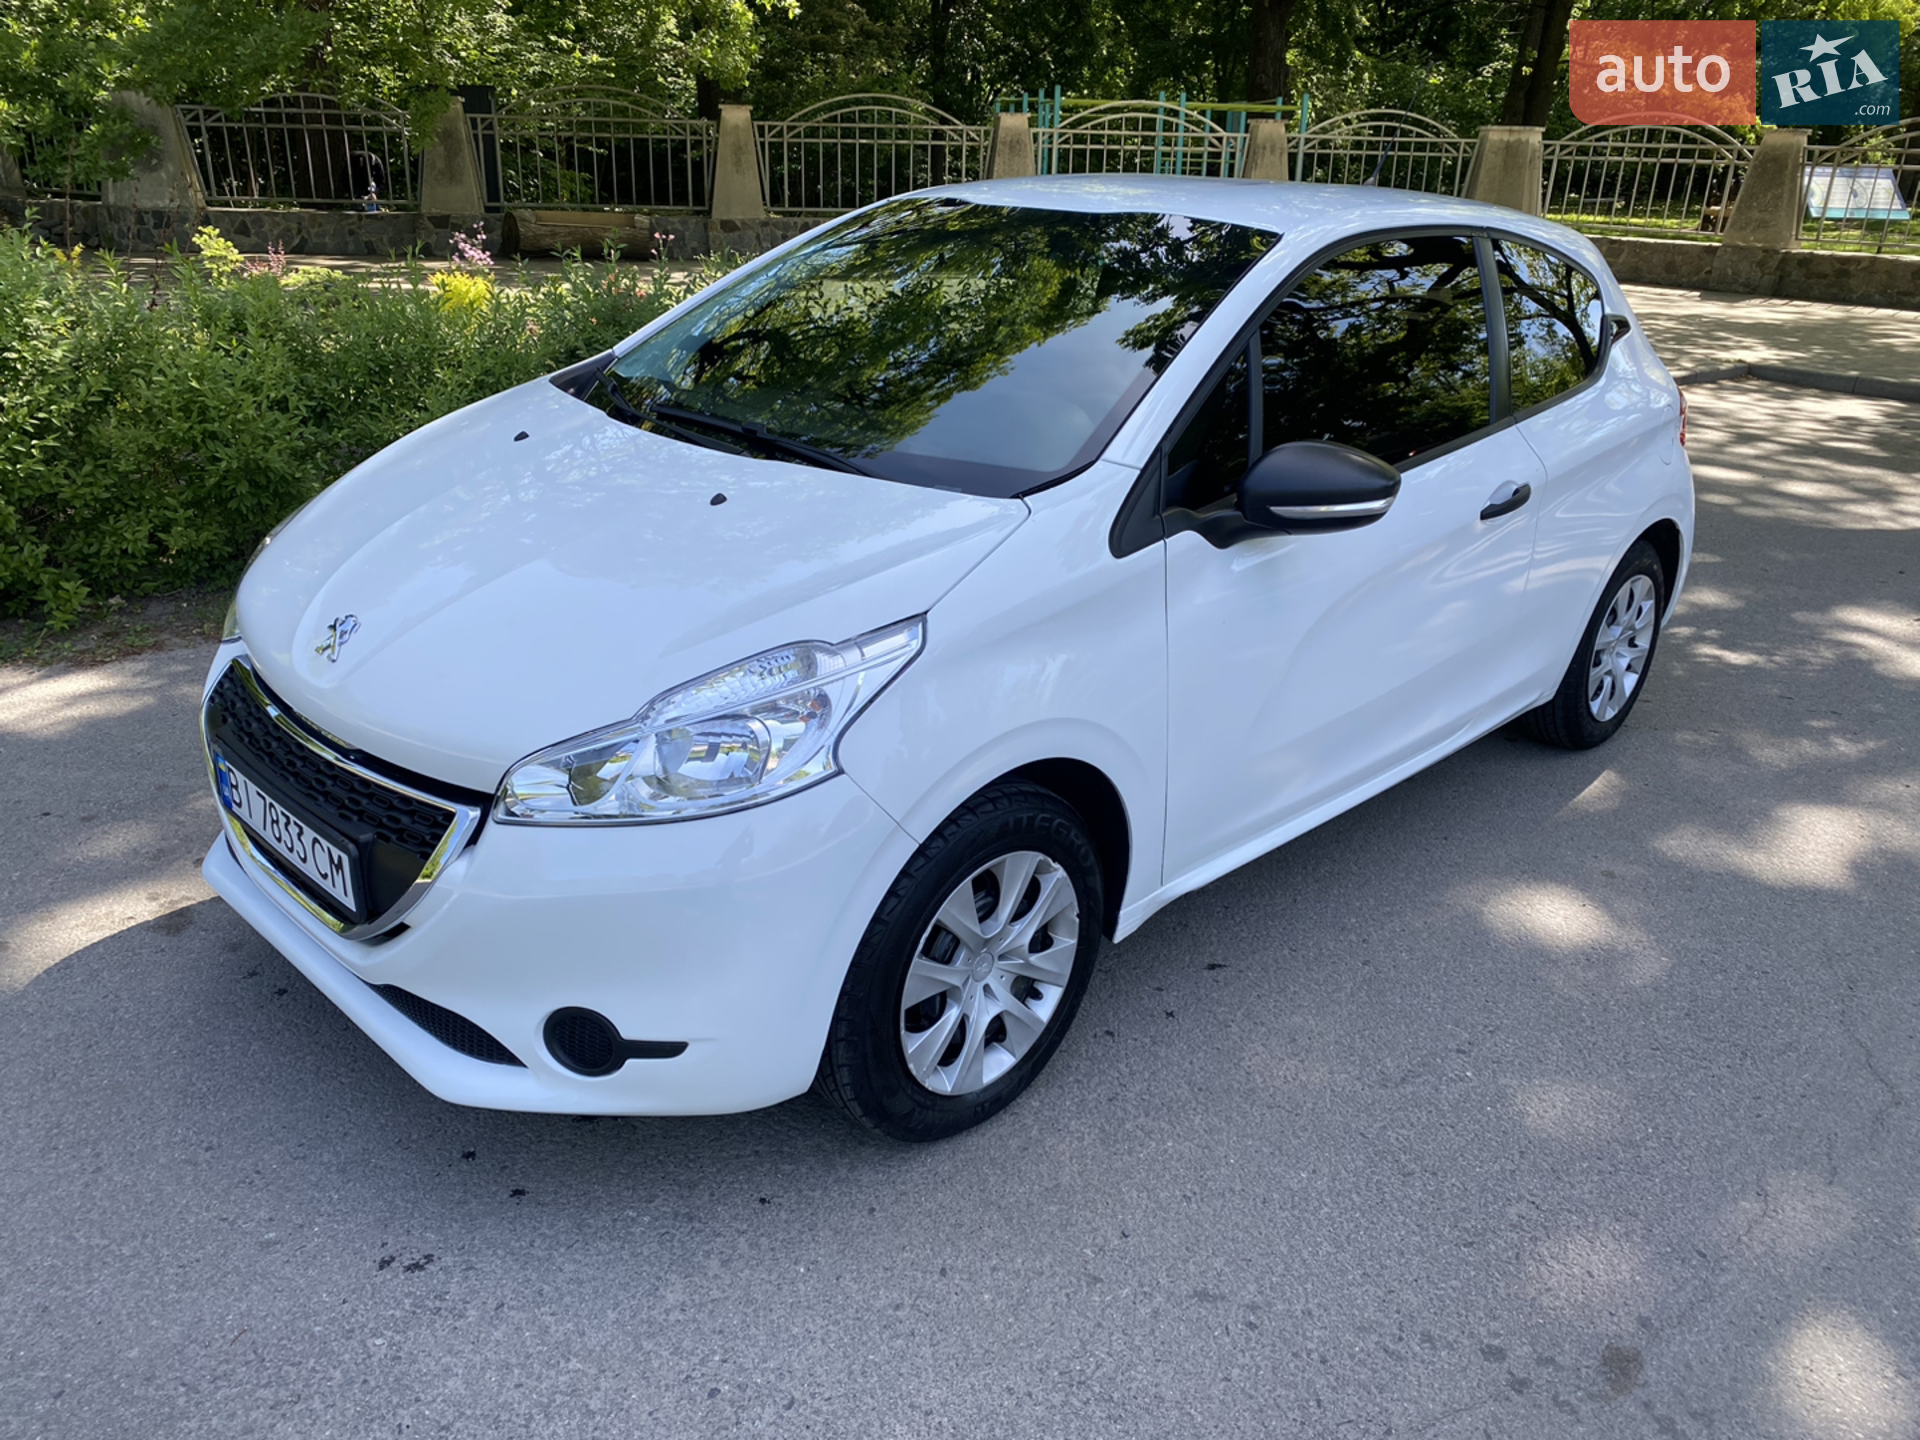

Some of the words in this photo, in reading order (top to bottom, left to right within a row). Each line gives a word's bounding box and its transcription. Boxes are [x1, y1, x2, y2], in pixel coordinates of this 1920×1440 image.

[227, 766, 253, 820] BI
[256, 790, 308, 865] 7833
[311, 836, 349, 898] CM
